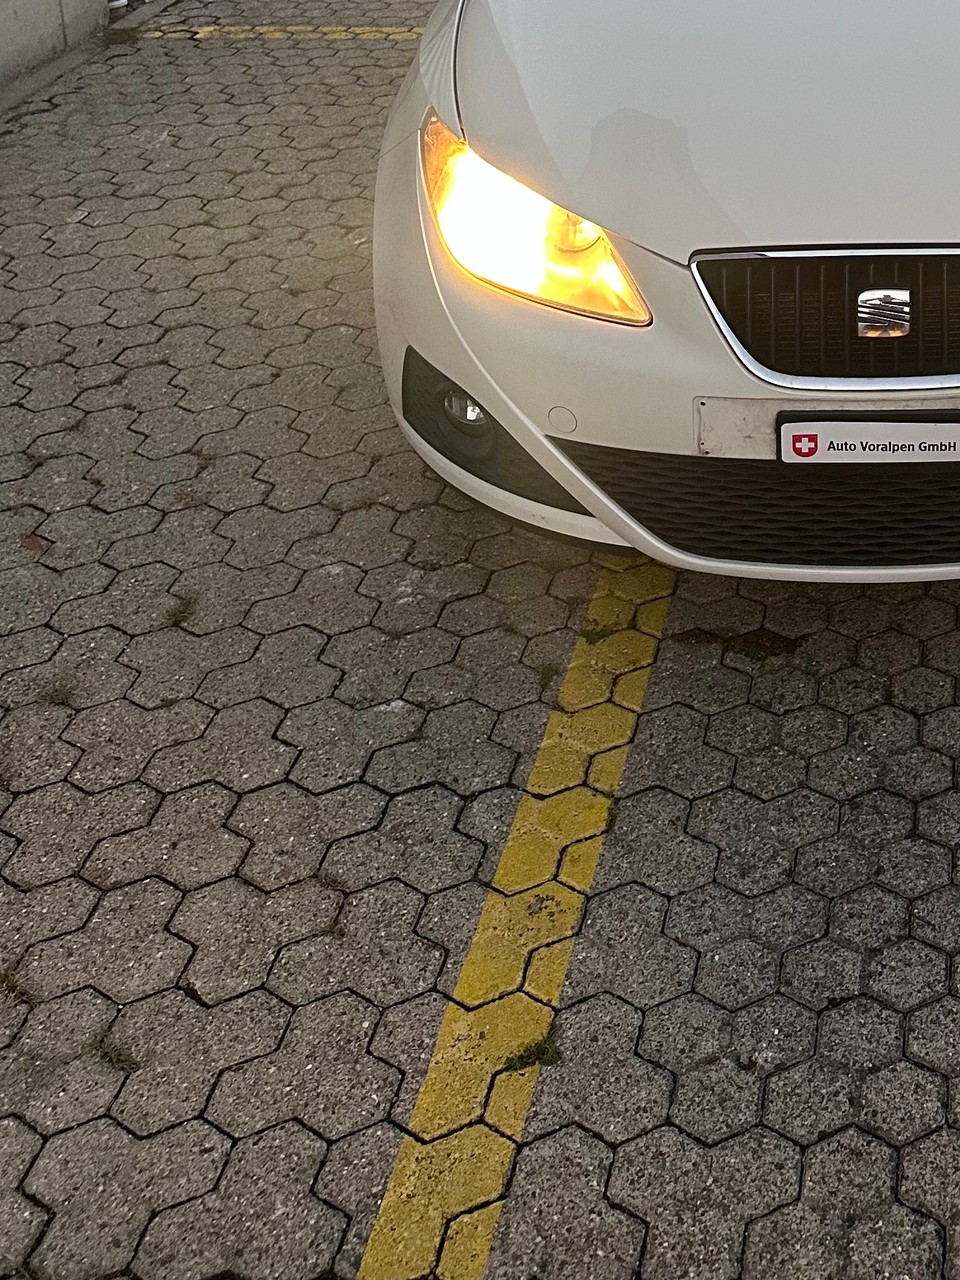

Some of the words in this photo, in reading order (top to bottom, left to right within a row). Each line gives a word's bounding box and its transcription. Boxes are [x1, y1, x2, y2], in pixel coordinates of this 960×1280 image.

[827, 441, 857, 452] Auto
[860, 441, 915, 454] Voralpen
[918, 441, 957, 452] GmbH
